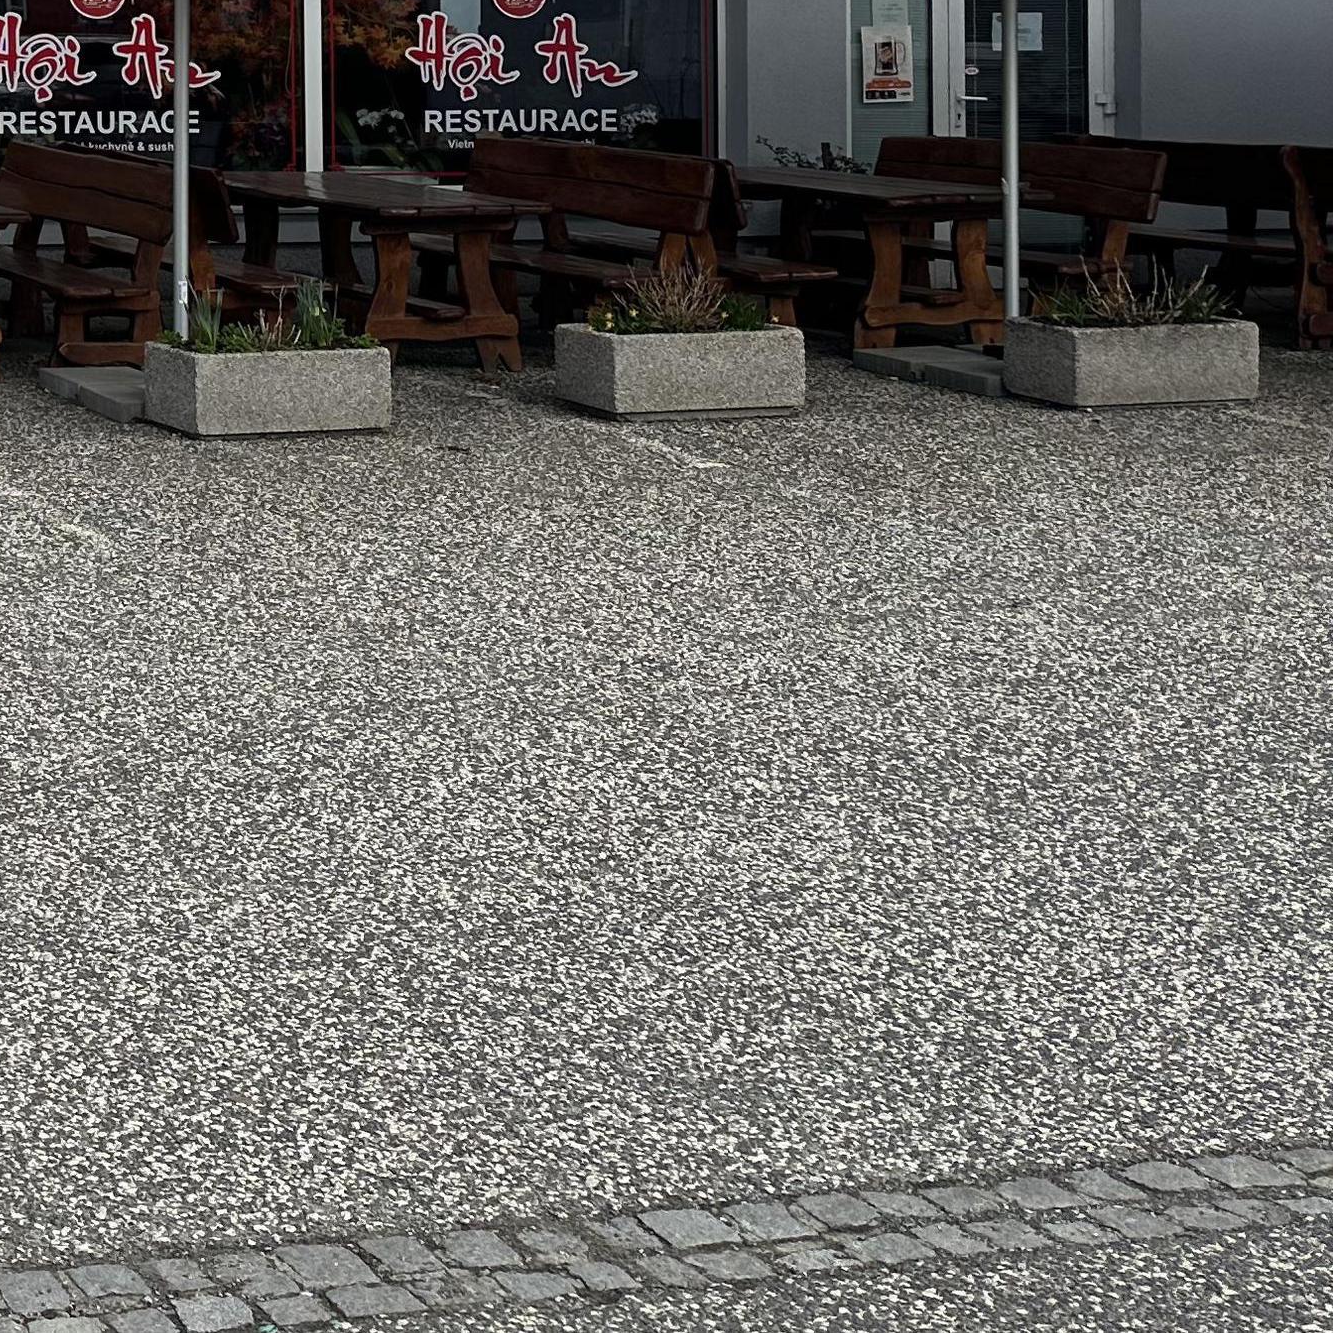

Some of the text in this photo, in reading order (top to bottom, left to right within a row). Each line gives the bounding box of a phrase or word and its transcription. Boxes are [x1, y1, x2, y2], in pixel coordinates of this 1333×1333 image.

[113, 13, 222, 99] An
[534, 12, 638, 98] An
[137, 142, 145, 151] &
[148, 141, 174, 152] sush
[424, 109, 618, 133] RESTAURACE
